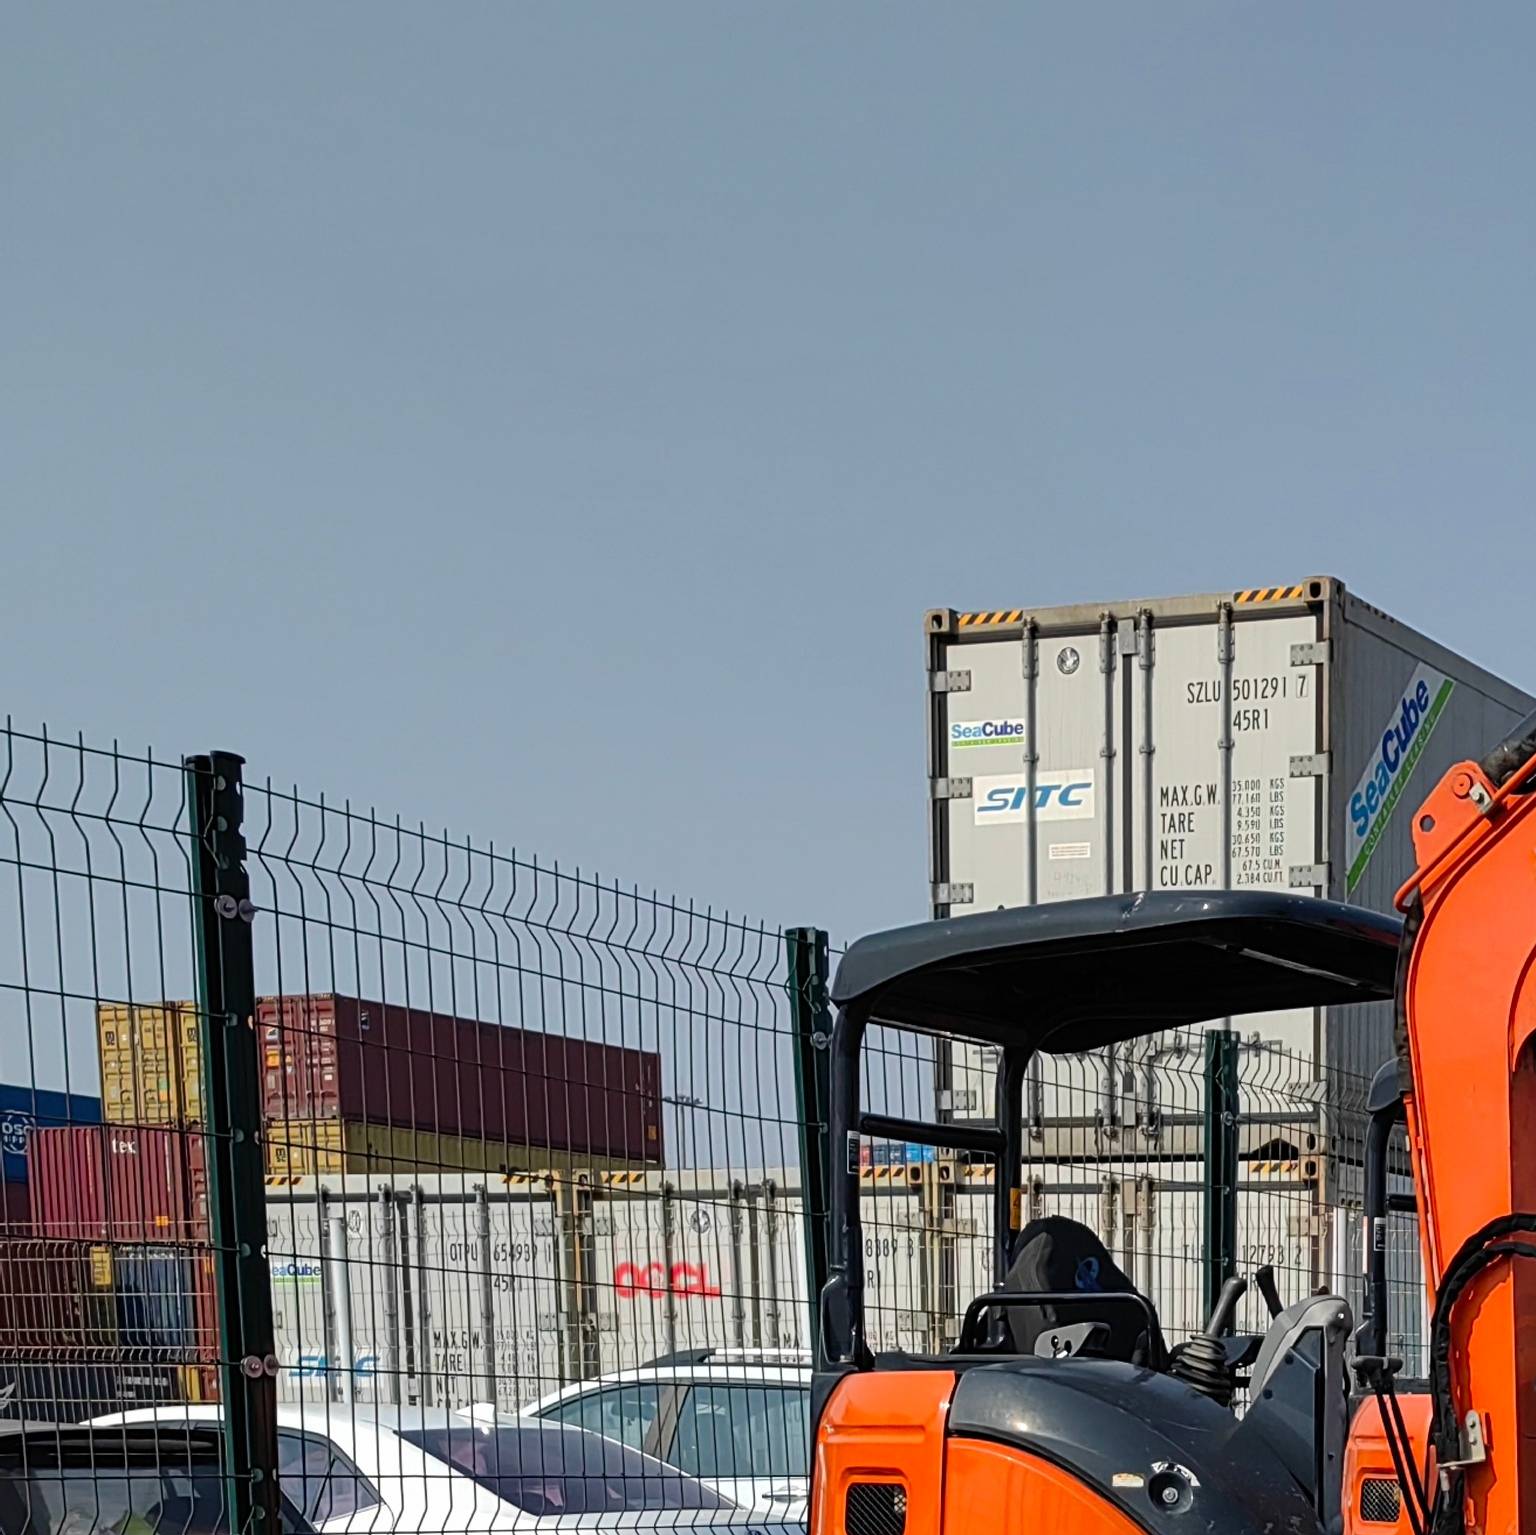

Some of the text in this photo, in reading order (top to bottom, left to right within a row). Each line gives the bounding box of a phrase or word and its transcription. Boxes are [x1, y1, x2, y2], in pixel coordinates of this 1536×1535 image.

[1187, 676, 1306, 704] SZLU 501291 7
[951, 720, 1024, 739] SeaCube
[1232, 709, 1269, 731] 45R1
[1350, 679, 1430, 838] SeaCube
[977, 782, 1092, 812] SITC
[1161, 812, 1195, 834] TARE
[1160, 838, 1186, 860] NET
